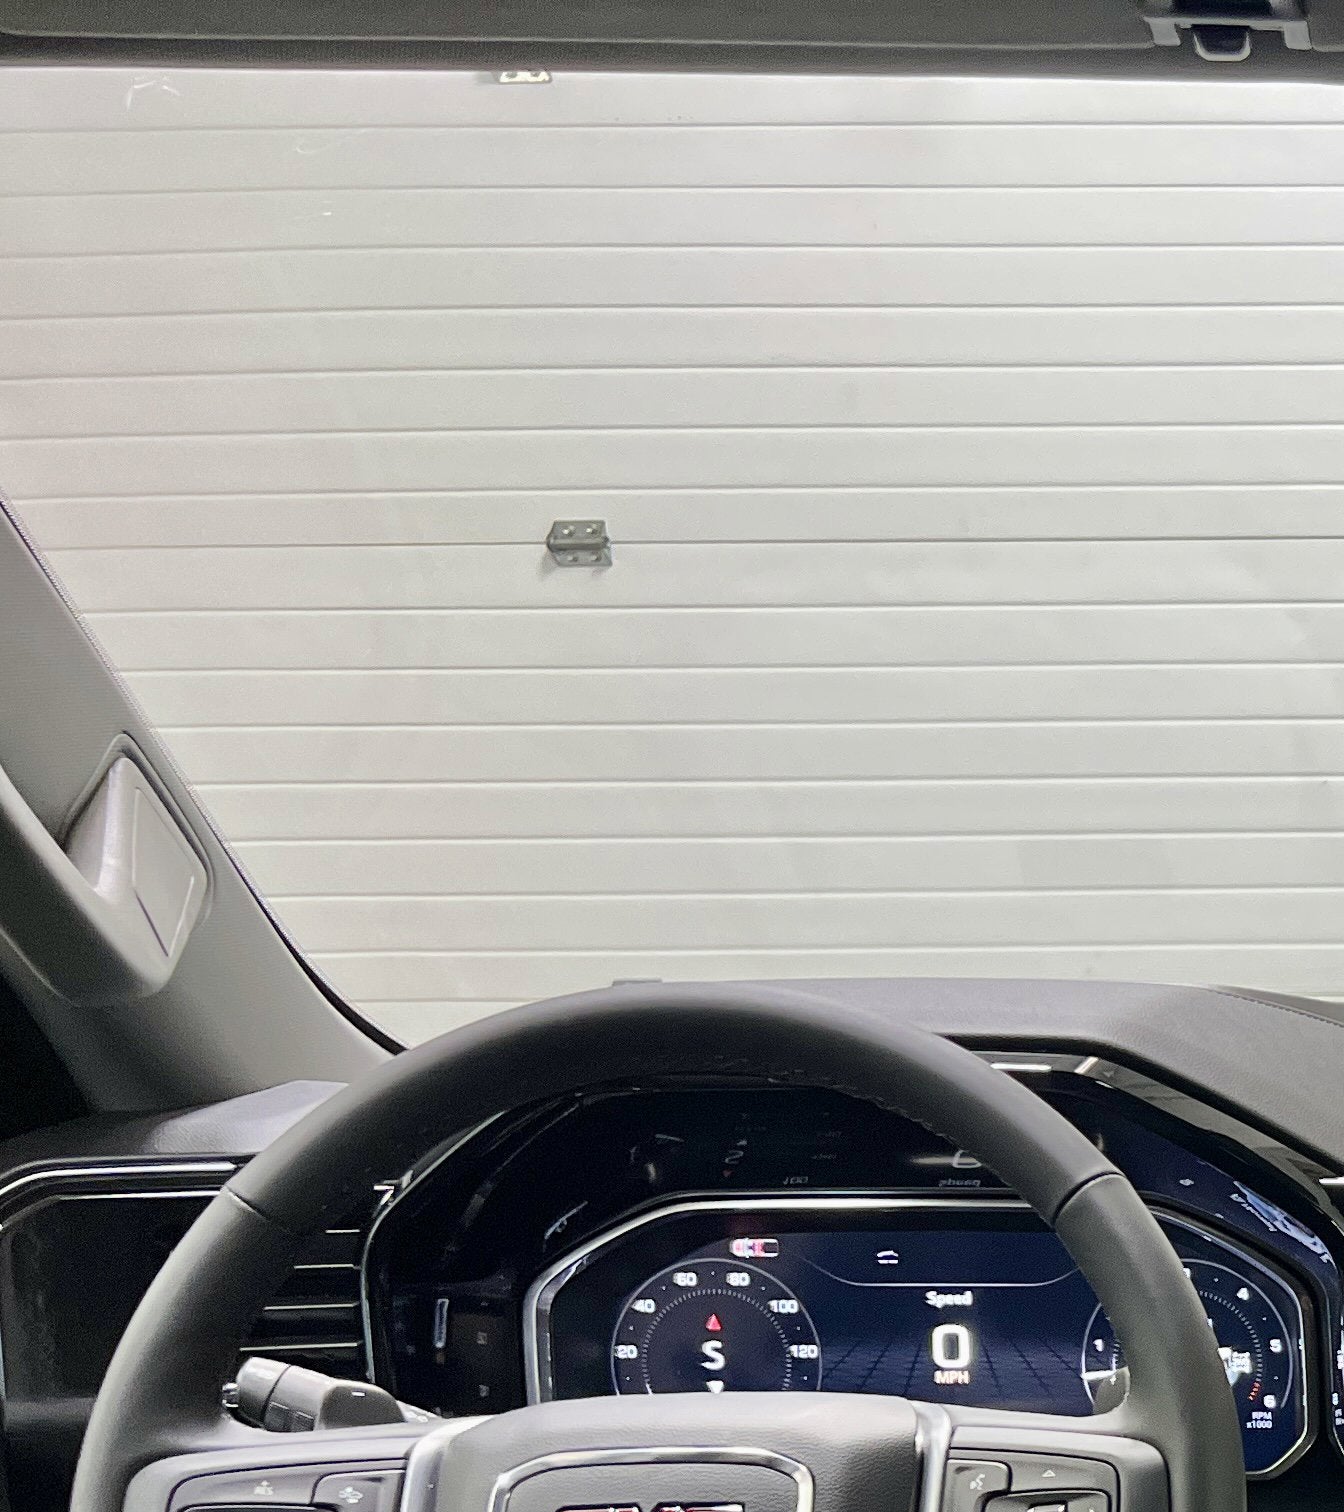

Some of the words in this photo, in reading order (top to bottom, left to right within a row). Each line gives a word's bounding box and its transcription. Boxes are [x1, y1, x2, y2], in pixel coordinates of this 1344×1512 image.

[673, 1272, 698, 1287] 60
[768, 1300, 799, 1314] 100
[925, 1290, 973, 1309] Speed
[788, 1344, 819, 1359] 120
[932, 1323, 970, 1369] 0
[701, 1340, 725, 1370] S
[933, 1370, 970, 1384] MPH
[1252, 1411, 1272, 1420] RPM
